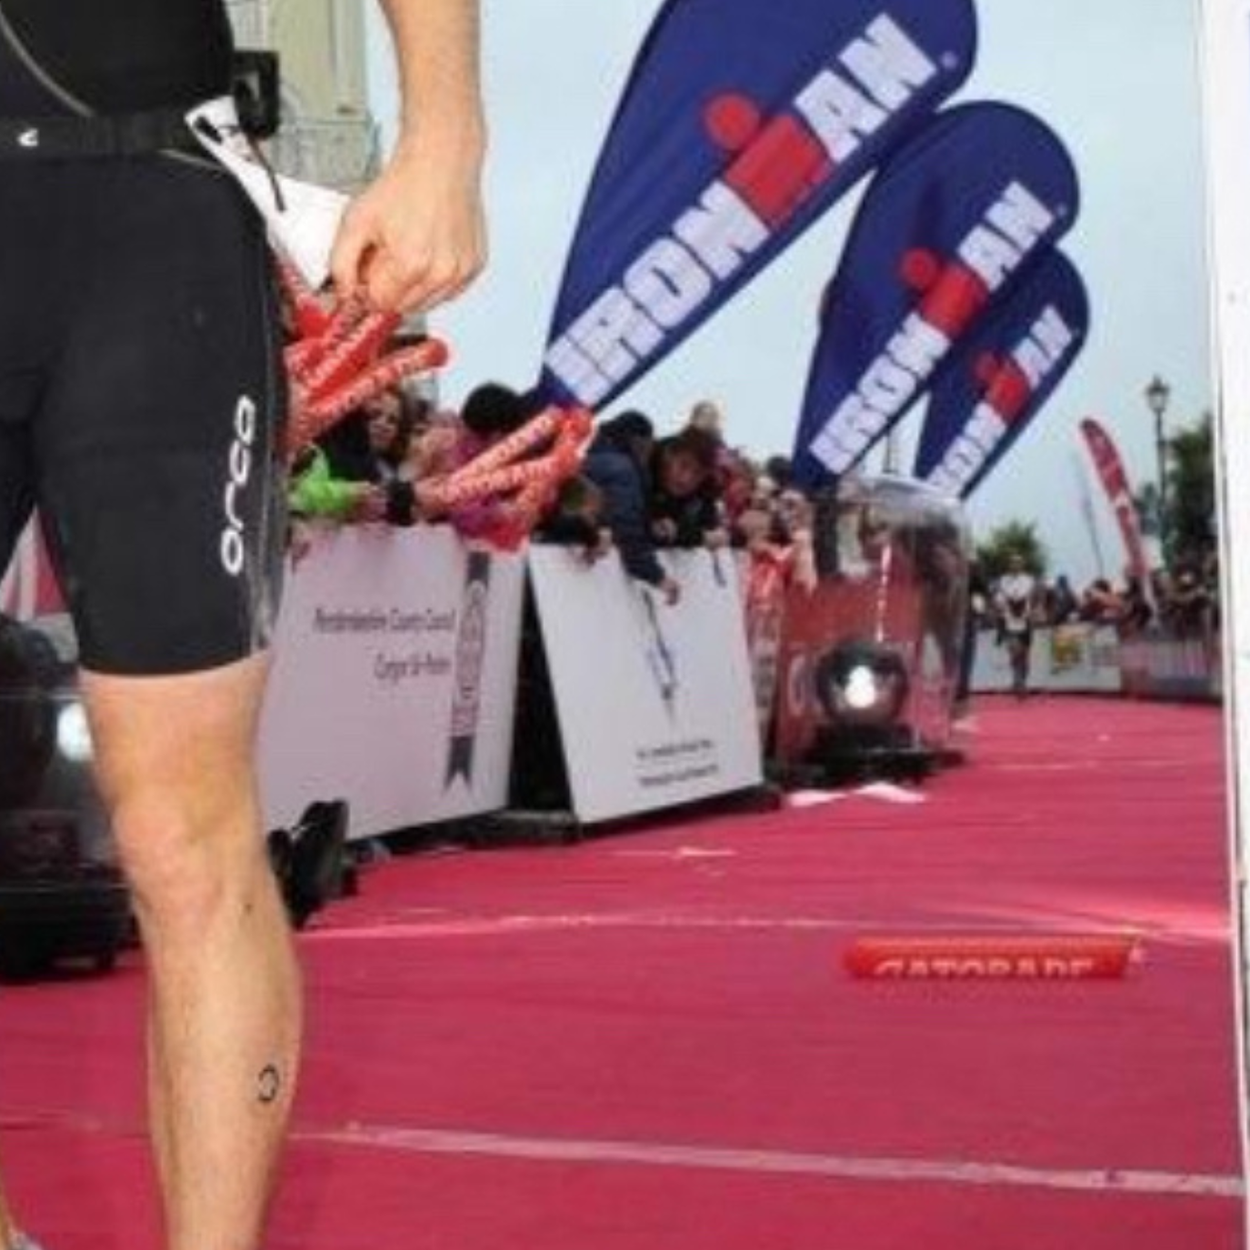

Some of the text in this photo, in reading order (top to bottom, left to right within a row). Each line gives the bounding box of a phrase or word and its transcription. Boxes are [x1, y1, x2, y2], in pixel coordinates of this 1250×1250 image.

[544, 12, 938, 408] IRONMAN
[809, 180, 1054, 475] IRONMAN
[220, 394, 256, 577] orca
[926, 304, 1073, 492] ONMAN
